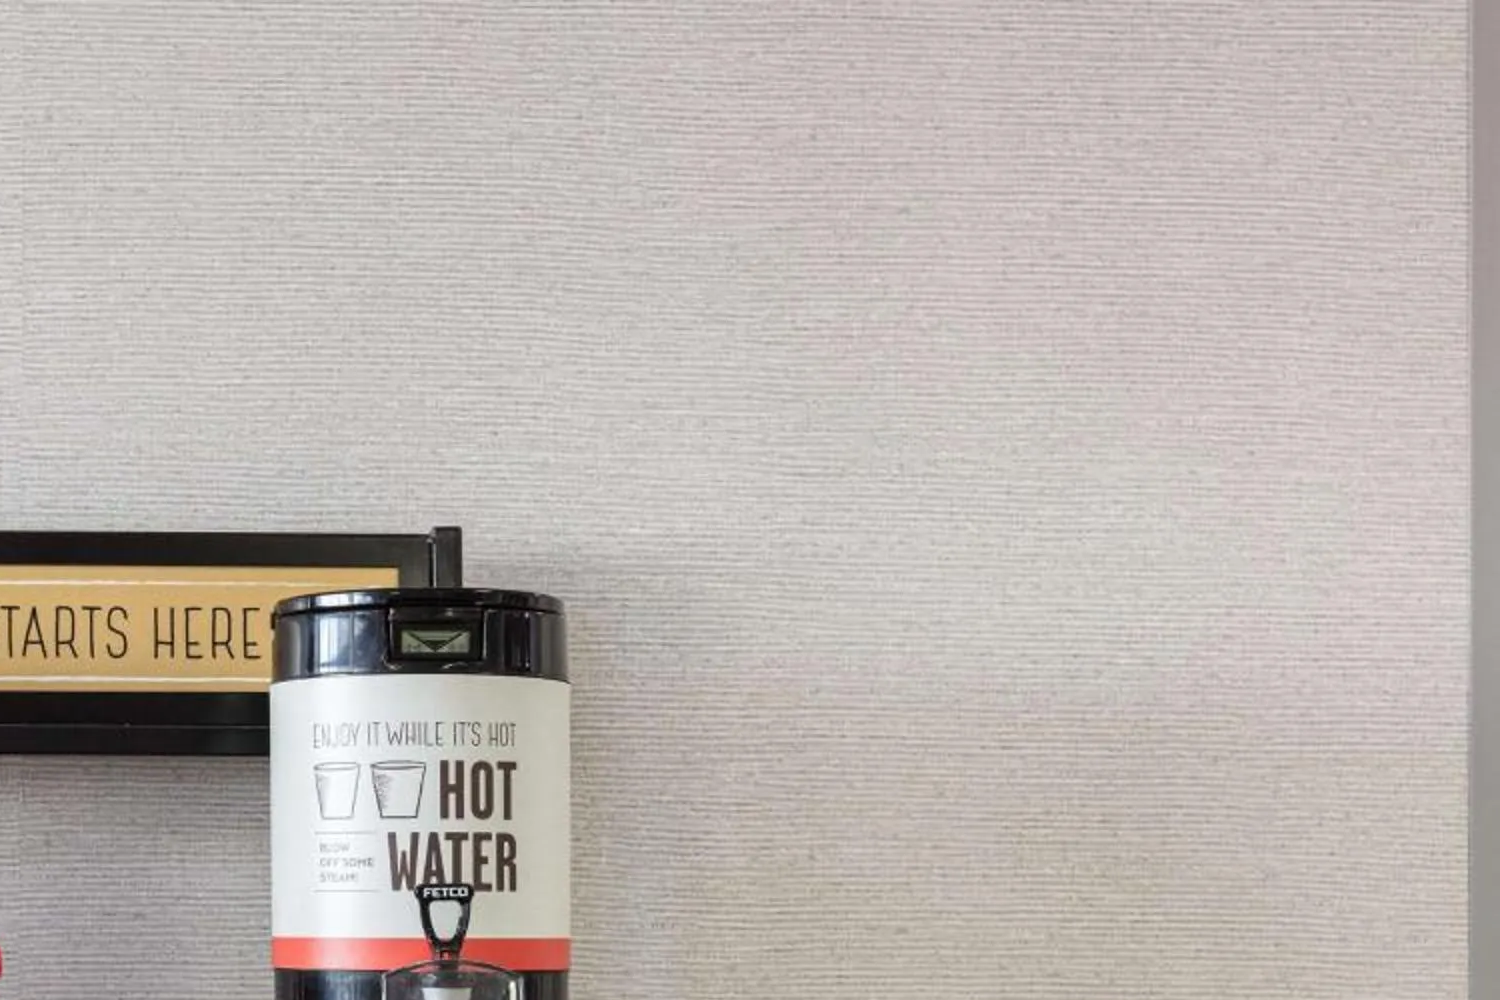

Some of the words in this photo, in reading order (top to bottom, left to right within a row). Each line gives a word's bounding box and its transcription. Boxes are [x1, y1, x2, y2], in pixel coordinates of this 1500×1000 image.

[153, 606, 261, 660] HERE
[313, 722, 361, 749] ENJOY
[367, 722, 381, 746] IT
[385, 721, 444, 746] WHILE
[453, 721, 482, 747] IT'S
[488, 722, 516, 747] HOT
[439, 760, 517, 820] HOT
[387, 832, 517, 892] WATER
[423, 887, 469, 898] FETCO
